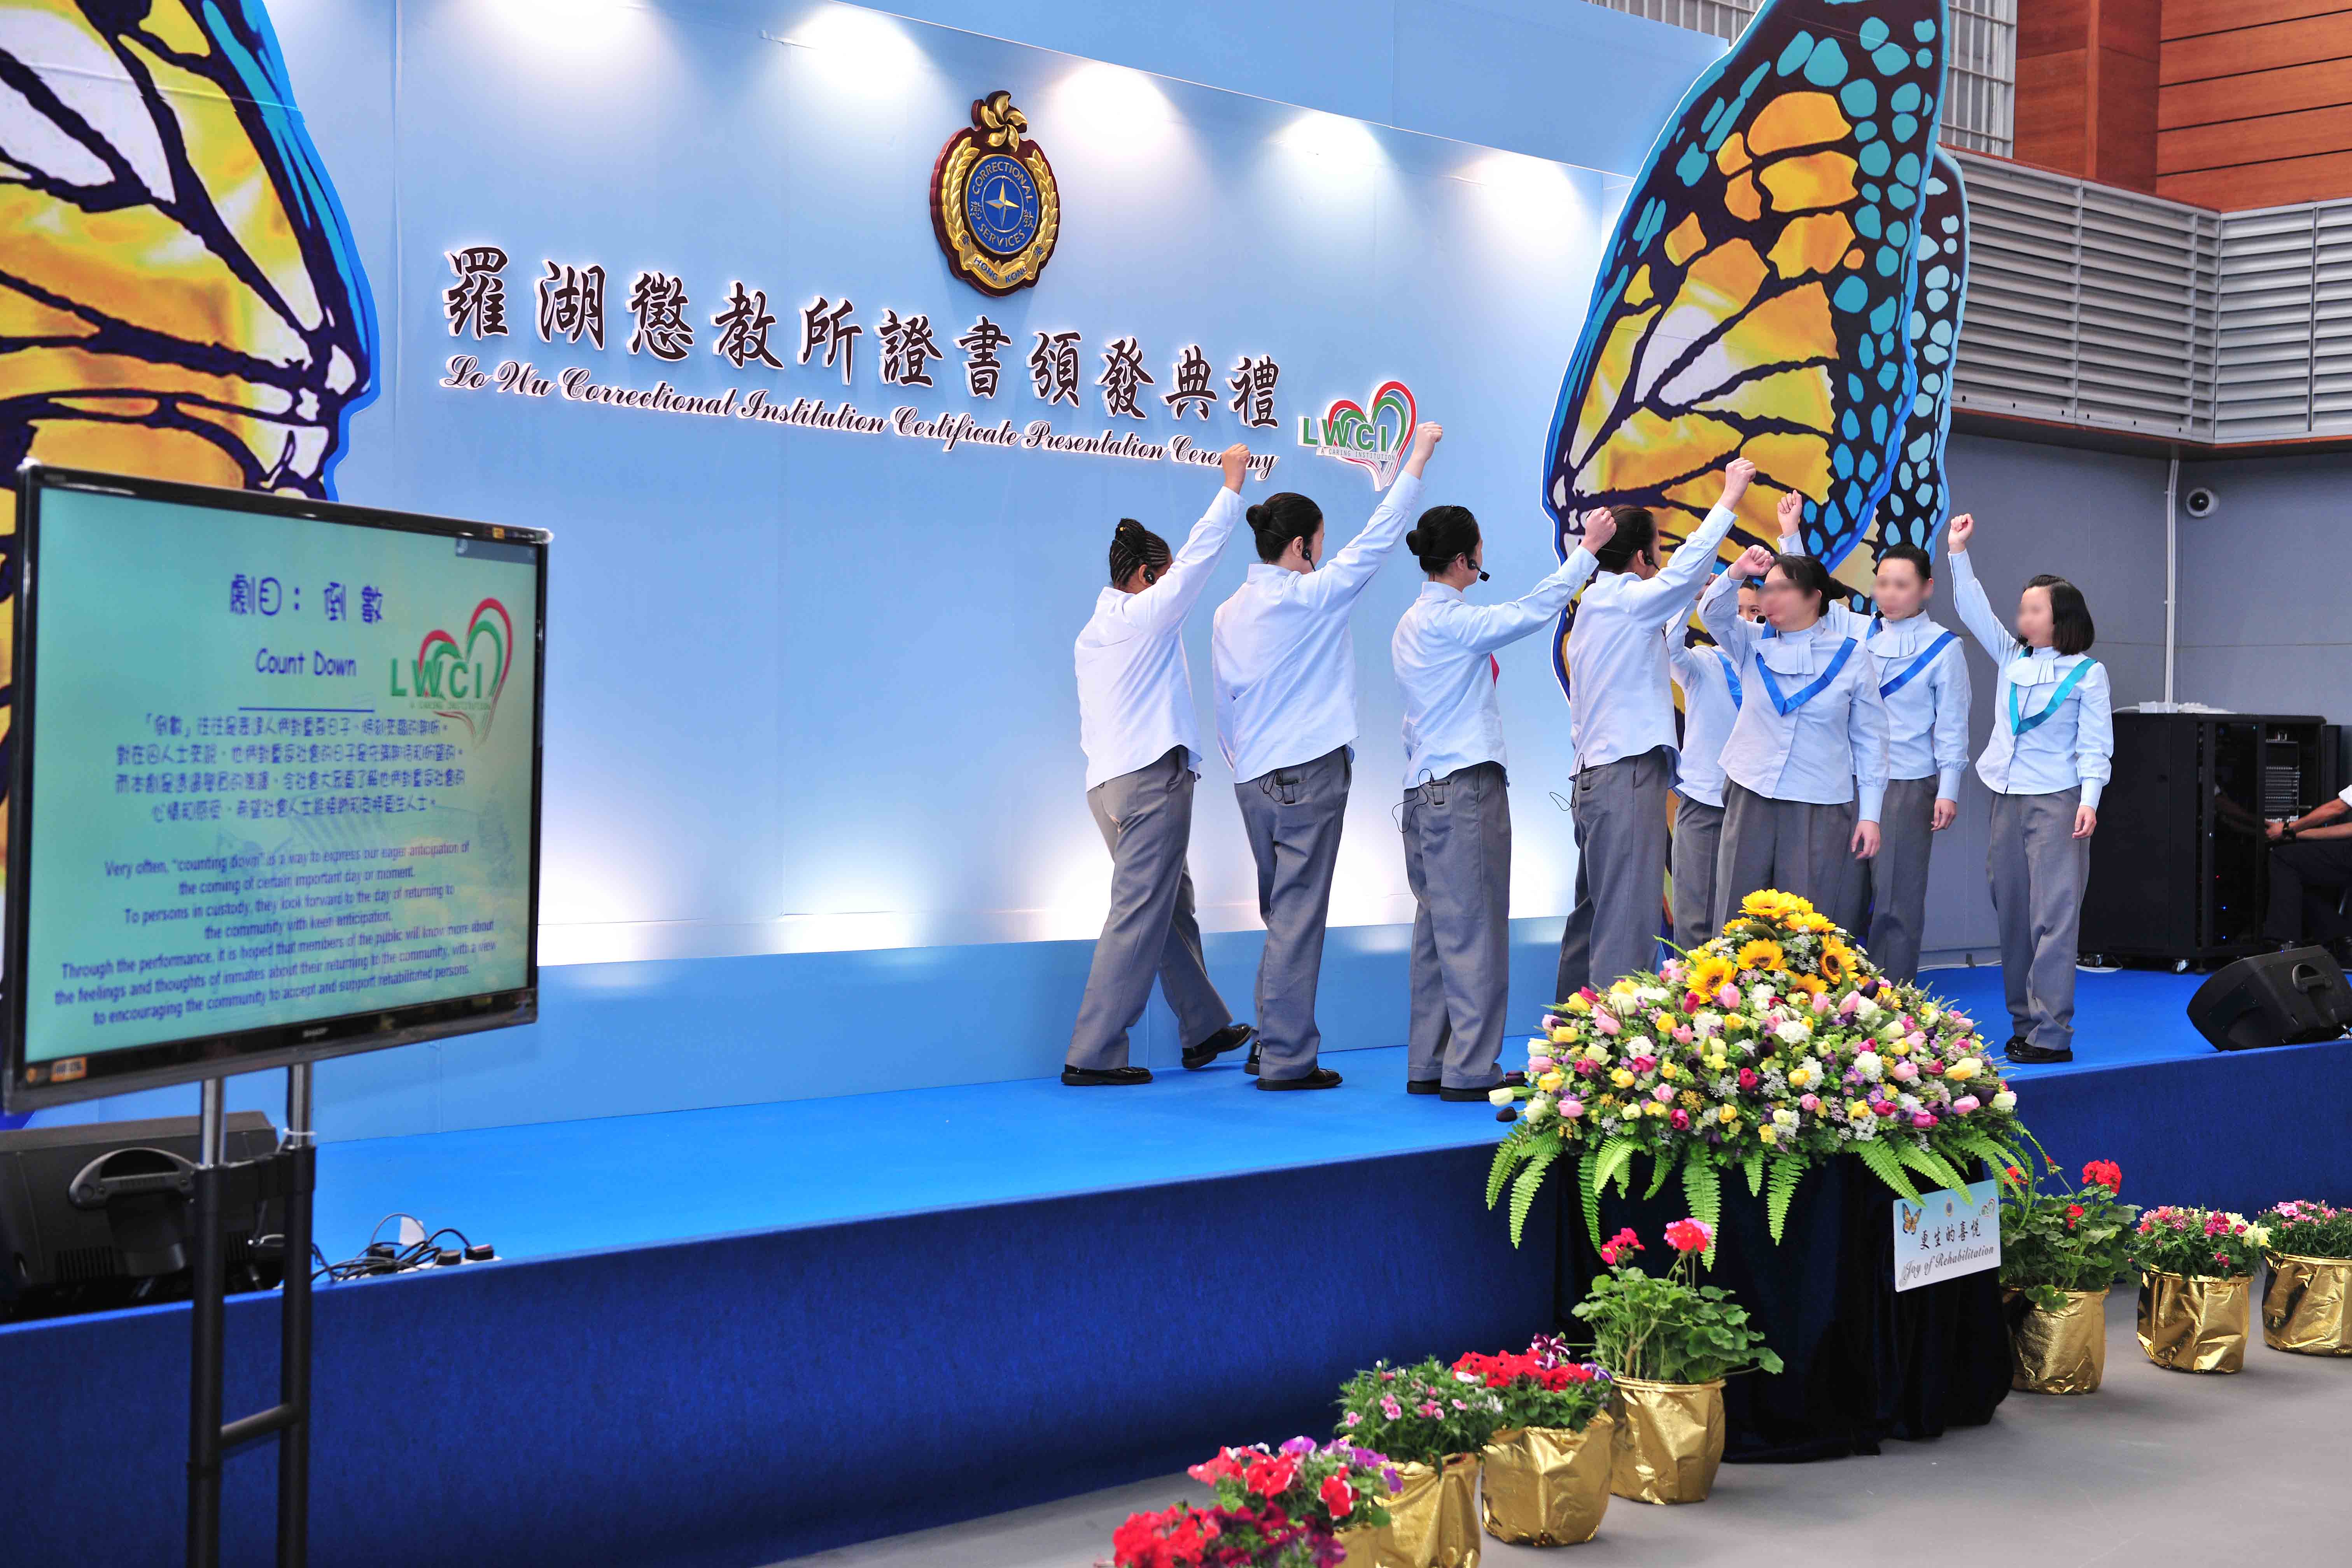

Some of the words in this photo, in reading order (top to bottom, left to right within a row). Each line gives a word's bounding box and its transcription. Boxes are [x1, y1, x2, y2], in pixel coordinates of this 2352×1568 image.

[973, 161, 1033, 203] CORRECTIONAL
[978, 224, 1026, 247] SERVICES
[973, 257, 999, 281] HONG
[1005, 266, 1027, 283] KONG
[446, 246, 1279, 428] 羅湖懲教所證書頒發典禮
[444, 355, 492, 388] Lo
[497, 361, 555, 396] Wu
[562, 367, 737, 415] Correctional
[741, 390, 889, 432] Institution
[895, 407, 1020, 450] Certificate
[1026, 421, 1168, 460] Presentation
[1172, 435, 1279, 480] Cereny
[1303, 417, 1388, 452] LWCI
[1355, 451, 1395, 461] INSTITUTION
[255, 647, 305, 675] Count
[313, 650, 357, 677] Down
[390, 658, 482, 699] LWCI
[104, 860, 133, 879] Very
[289, 853, 308, 866] way
[311, 851, 320, 862] to
[324, 849, 360, 863] express
[364, 849, 379, 859] our
[382, 848, 406, 861] eager
[410, 842, 459, 858] anticipation
[462, 840, 469, 853] of
[178, 881, 196, 895] the
[200, 879, 240, 895] coming
[243, 876, 254, 889] of
[257, 875, 292, 889] certain
[296, 872, 342, 889] important
[345, 869, 361, 884] day
[365, 870, 373, 880] or
[376, 865, 415, 880] moment.
[123, 908, 140, 923] To
[142, 908, 189, 926] persons
[192, 905, 203, 918] in
[255, 898, 278, 914] they
[280, 896, 301, 909] look
[304, 892, 343, 908] forward
[345, 892, 353, 904] to
[357, 890, 371, 903] the
[375, 888, 390, 904] day
[394, 886, 402, 899] of
[404, 884, 444, 899] returning
[445, 884, 455, 895] to
[204, 924, 222, 940] the
[225, 920, 283, 938] community
[286, 917, 306, 932] with
[310, 916, 334, 929] keen
[337, 911, 393, 926] anticipation.
[61, 959, 114, 979] Through
[116, 958, 136, 973] the
[217, 948, 225, 962] it
[228, 947, 237, 960] is
[240, 942, 273, 960] hoped
[276, 941, 296, 956] that
[298, 936, 344, 952] members
[348, 933, 357, 947] of
[359, 933, 373, 945] the
[376, 929, 402, 947] public
[405, 926, 420, 940] will
[423, 925, 444, 939] know
[448, 923, 469, 935] more
[471, 921, 495, 932] about
[54, 989, 74, 1006] the
[77, 985, 126, 1003] feelings
[129, 979, 152, 996] and
[155, 975, 206, 993] thoughts
[209, 971, 220, 987] of
[223, 968, 265, 985] inmates
[268, 963, 298, 979] about
[301, 959, 322, 973] their
[324, 955, 368, 971] returning
[371, 953, 380, 966] to
[382, 952, 396, 964] the
[453, 943, 469, 955] with
[471, 943, 477, 953] a
[479, 940, 497, 951] view
[93, 1010, 106, 1026] to
[108, 1002, 183, 1022] encouraging
[185, 998, 203, 1012] the
[206, 990, 266, 1010] community
[269, 988, 280, 1001] to
[282, 983, 316, 999] accept
[318, 980, 337, 994] and
[340, 975, 375, 992] support
[378, 968, 432, 986] rehabilitated
[1903, 1260, 1921, 1280] Joy
[1924, 1255, 1935, 1276] of
[1935, 1245, 1994, 1268] Rehabilitation
